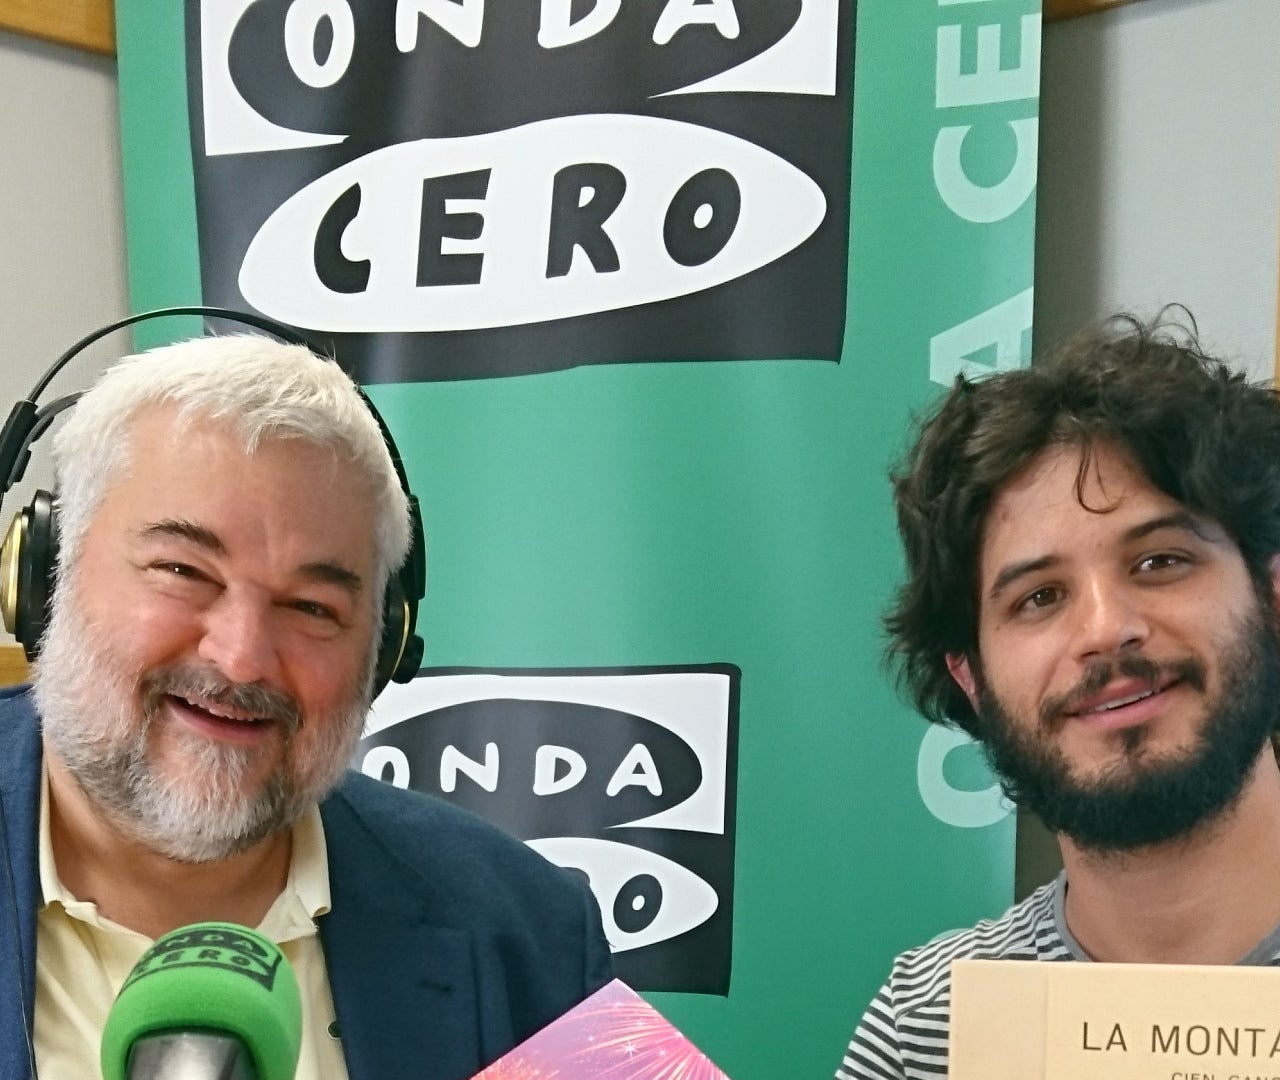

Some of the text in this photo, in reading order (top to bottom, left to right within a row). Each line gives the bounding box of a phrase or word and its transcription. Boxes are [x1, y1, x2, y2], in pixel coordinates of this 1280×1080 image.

[284, 0, 740, 88] ONDA
[933, 0, 1042, 223] CE
[314, 163, 742, 294] CERO
[362, 742, 663, 797] ONDA
[148, 934, 253, 955] NDA
[1082, 1021, 1127, 1052] LA
